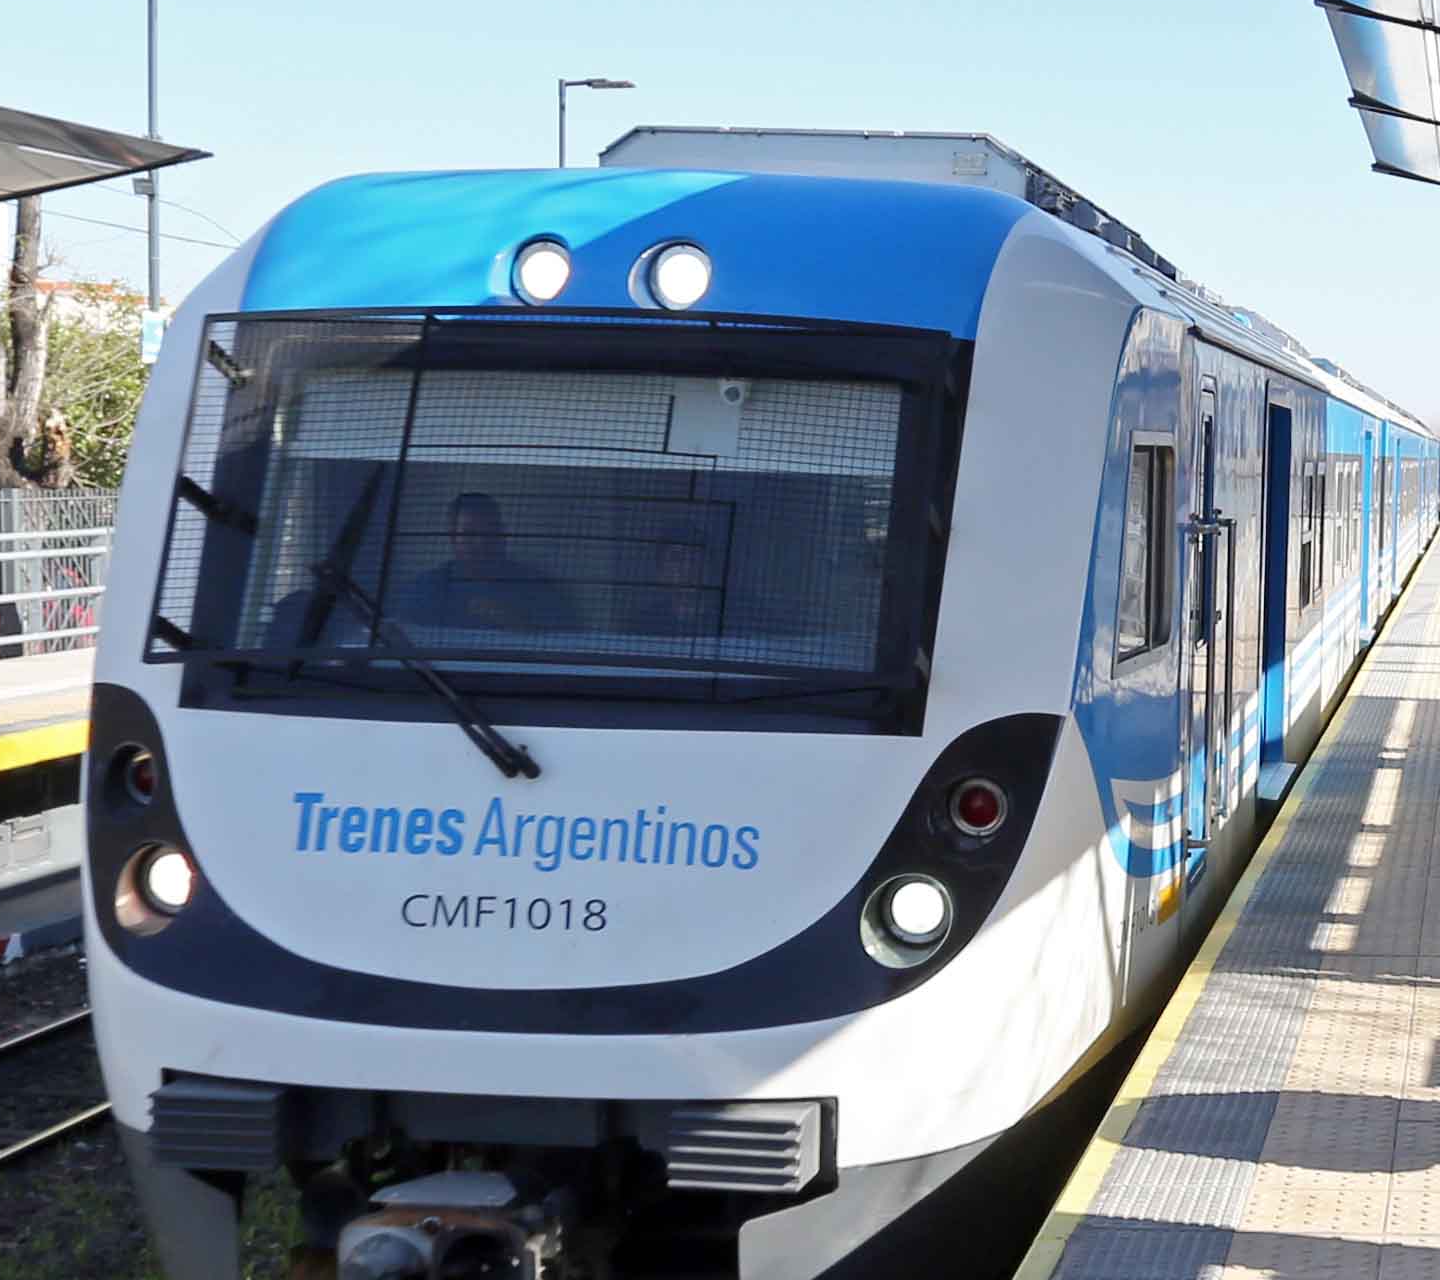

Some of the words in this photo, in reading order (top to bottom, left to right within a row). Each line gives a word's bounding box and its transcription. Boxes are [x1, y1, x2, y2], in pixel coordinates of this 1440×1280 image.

[292, 791, 466, 856] Trenes
[472, 796, 760, 872] Argentinos
[401, 893, 608, 932] CMF1018
